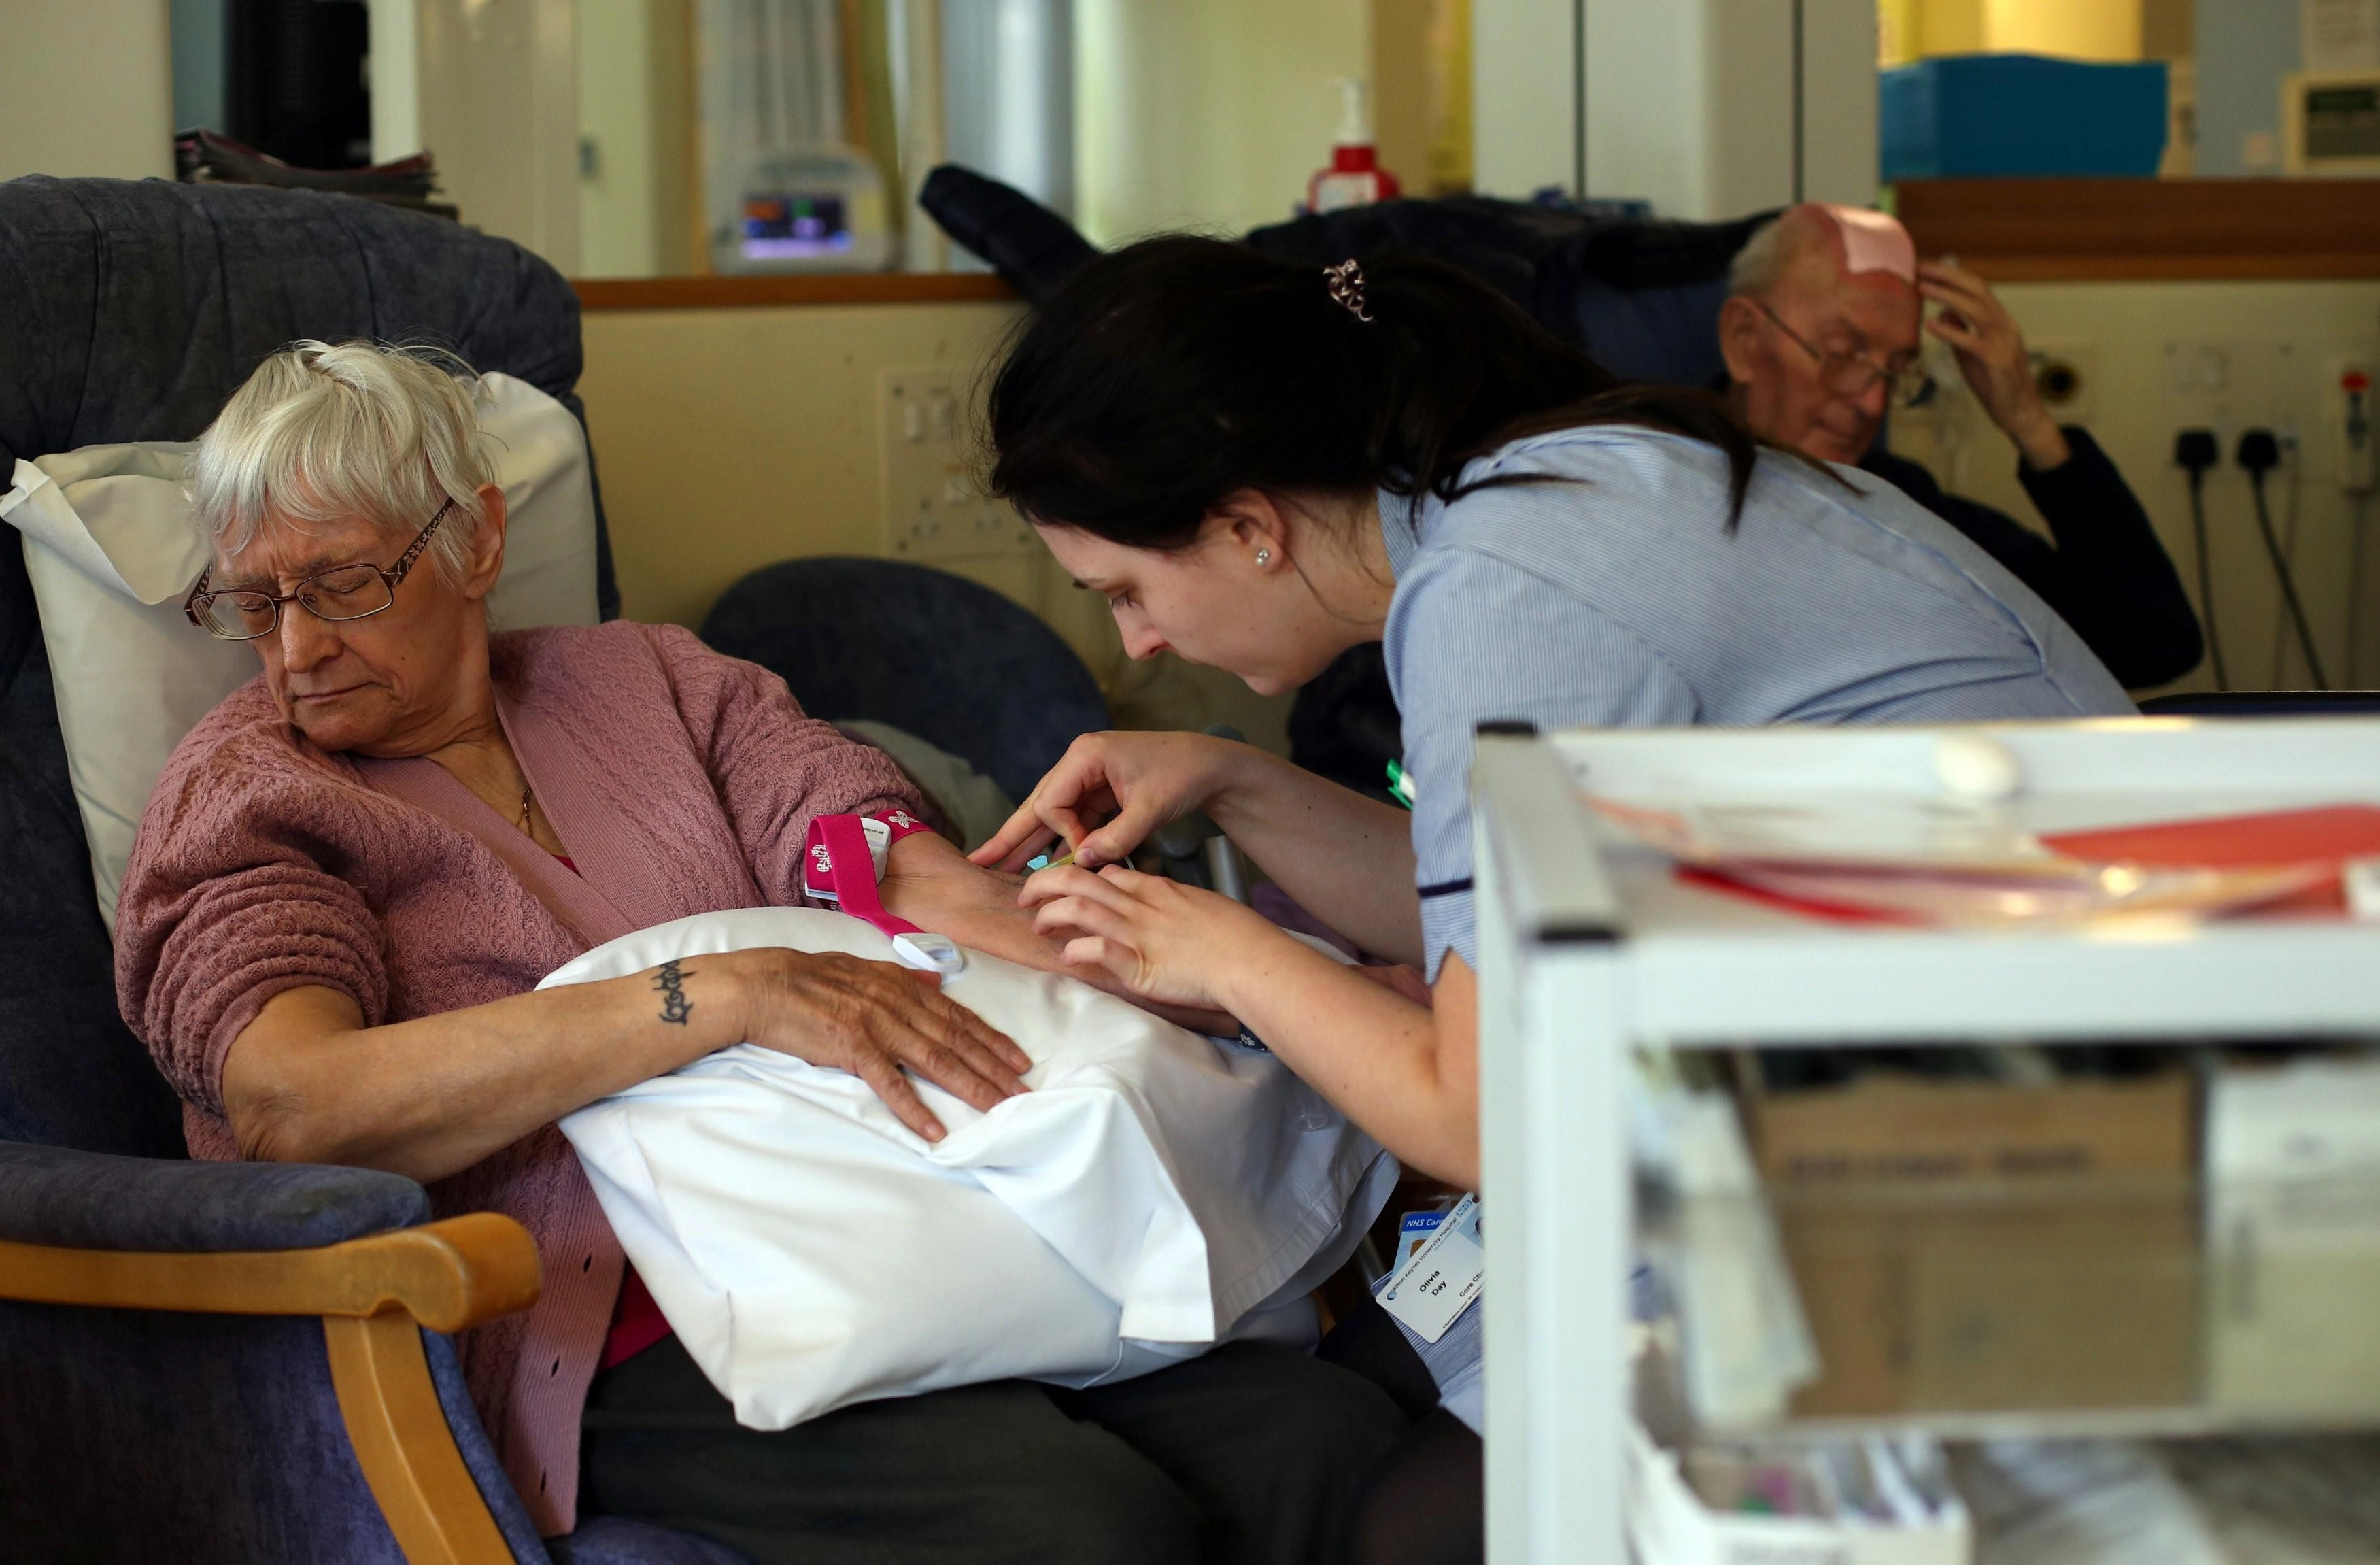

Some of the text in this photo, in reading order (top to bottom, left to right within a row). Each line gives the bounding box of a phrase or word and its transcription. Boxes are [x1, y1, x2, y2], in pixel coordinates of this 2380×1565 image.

[1457, 1200, 1472, 1217] NHS
[1405, 1261, 1420, 1277] Keynes
[1419, 1237, 1440, 1260] University
[1440, 1217, 1457, 1237] Hospital
[1419, 1270, 1440, 1292] Olivia
[1431, 1281, 1446, 1296] Day
[1459, 1268, 1484, 1297] Core Clin
